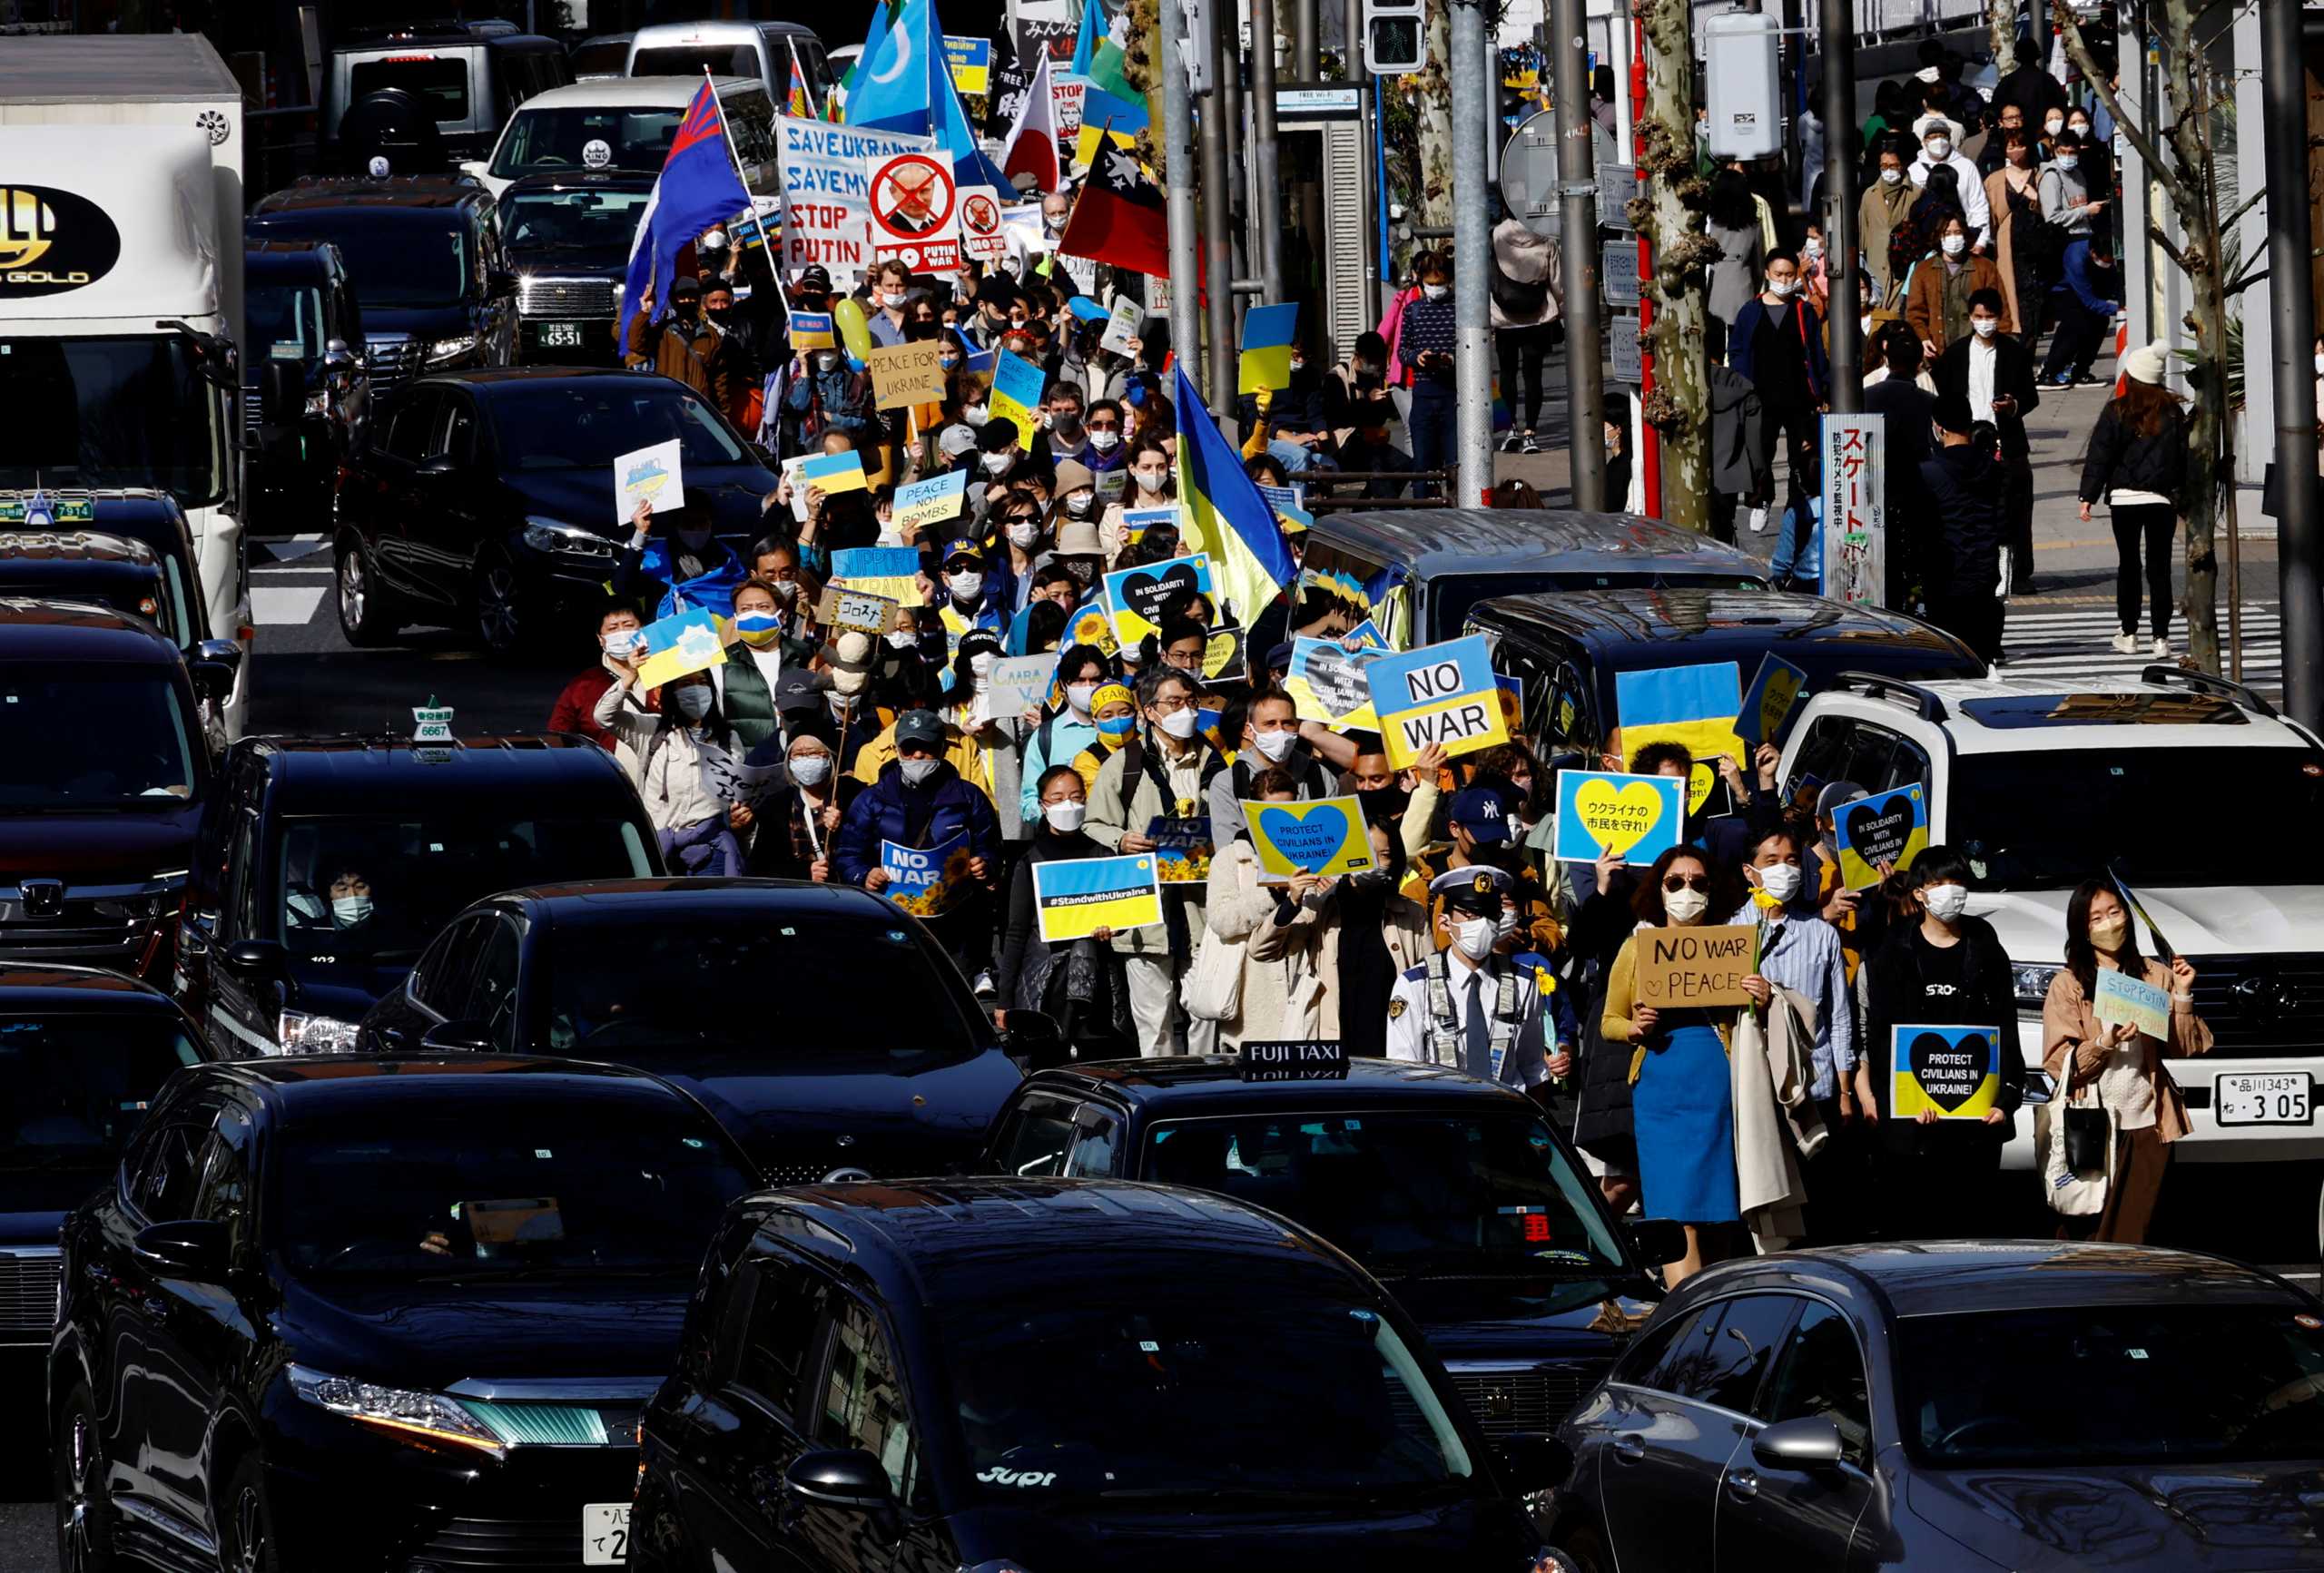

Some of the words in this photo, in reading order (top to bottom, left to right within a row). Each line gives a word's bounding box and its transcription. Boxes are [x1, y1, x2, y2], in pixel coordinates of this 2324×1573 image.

[1000, 72, 1022, 86] FREE
[1052, 84, 1083, 99] STOP
[790, 204, 847, 231] STOP
[791, 239, 861, 264] PUTIN
[876, 247, 920, 269] NO
[924, 245, 956, 258] PUTIN
[927, 257, 953, 268] WAR
[7, 271, 89, 283] GOLD
[547, 331, 581, 345] 65-51
[872, 354, 909, 374] PEACE
[913, 351, 936, 367] FOR
[886, 375, 931, 396] UKRAINE
[906, 479, 949, 500] PEACE
[916, 495, 940, 509] NOT
[59, 506, 88, 516] 7914
[902, 504, 949, 527] BOMBS
[834, 549, 918, 576] SUPPORT
[1135, 588, 1144, 596] IN
[1145, 579, 1185, 595] SOLIDARITY
[1334, 675, 1354, 687] WITH
[1407, 664, 1461, 702] NO
[1318, 684, 1354, 698] CIVILIANS
[422, 726, 447, 736] 6667
[1403, 704, 1490, 750] WAR
[1482, 800, 1500, 819] NY
[1588, 802, 1649, 817] ウクライナの
[1162, 821, 1203, 834] NO
[1279, 823, 1324, 835] PROTECT
[1587, 818, 1649, 832] 市民を守れ!
[1858, 824, 1866, 833] IN
[1866, 813, 1903, 831] SOLIDARITY
[1277, 837, 1322, 848] CIVILIANS
[1324, 835, 1335, 845] IN
[1873, 830, 1890, 841] WITH
[1285, 849, 1332, 860] UKRAINE!
[1864, 841, 1895, 856] CIVILIANS
[1895, 838, 1903, 847] IN
[891, 848, 929, 869] NO
[883, 864, 941, 886] WAR
[1049, 887, 1147, 906] #StandwithUkraine
[1654, 937, 1698, 964] NO
[1704, 937, 1749, 959] WAR
[1669, 971, 1740, 999] PEACE
[2106, 977, 2136, 997] STOP
[1251, 1046, 1290, 1062] FUJI
[1295, 1045, 1340, 1060] TAXI
[1928, 1053, 1974, 1065] PROTECT
[1921, 1068, 1968, 1080] CIVILIANS
[1969, 1070, 1979, 1080] IN
[1925, 1084, 1973, 1096] UKRAINE!
[592, 1537, 606, 1552] て
